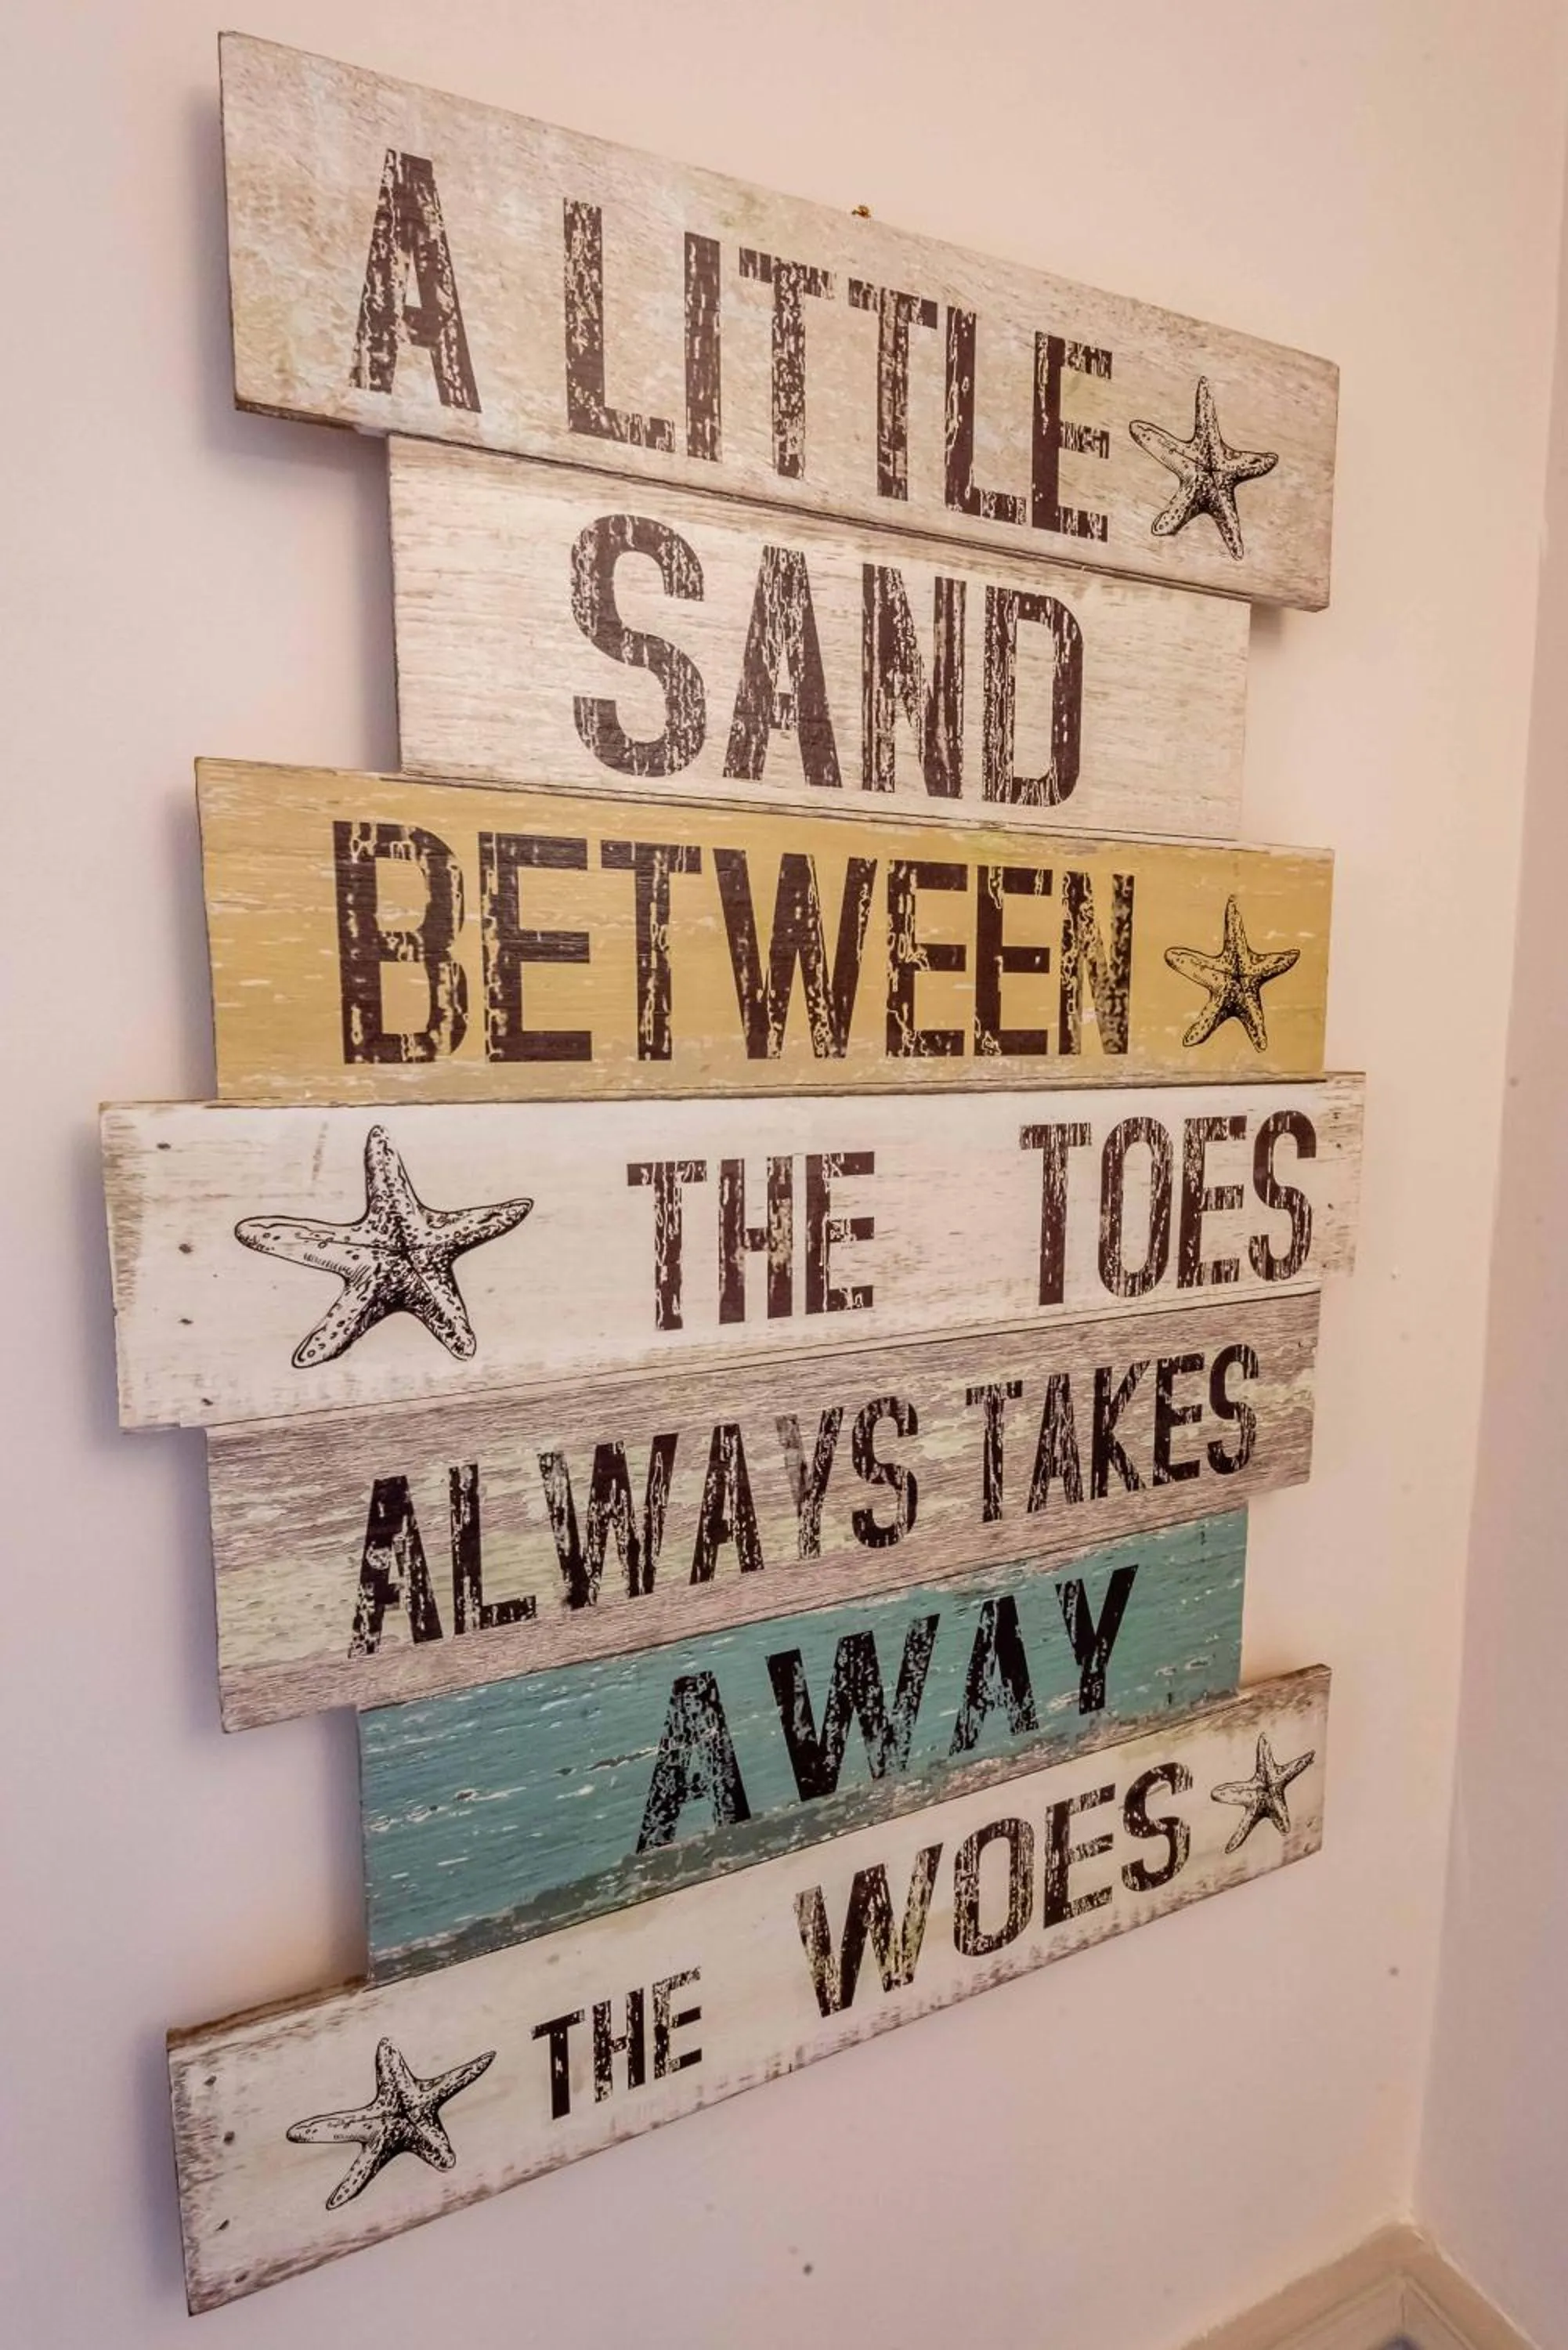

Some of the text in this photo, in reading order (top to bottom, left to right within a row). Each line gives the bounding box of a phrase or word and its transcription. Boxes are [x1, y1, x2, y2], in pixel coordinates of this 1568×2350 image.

[348, 149, 1113, 541] A LITTLE
[571, 514, 1083, 808] SAND
[333, 821, 1135, 1063] BETWEEN
[627, 1110, 1317, 1331] THE TOES
[349, 1343, 1257, 1658] ALWAYS TAKES
[636, 1566, 1139, 1854] AWAY
[533, 1762, 1193, 2120] THE WOES
